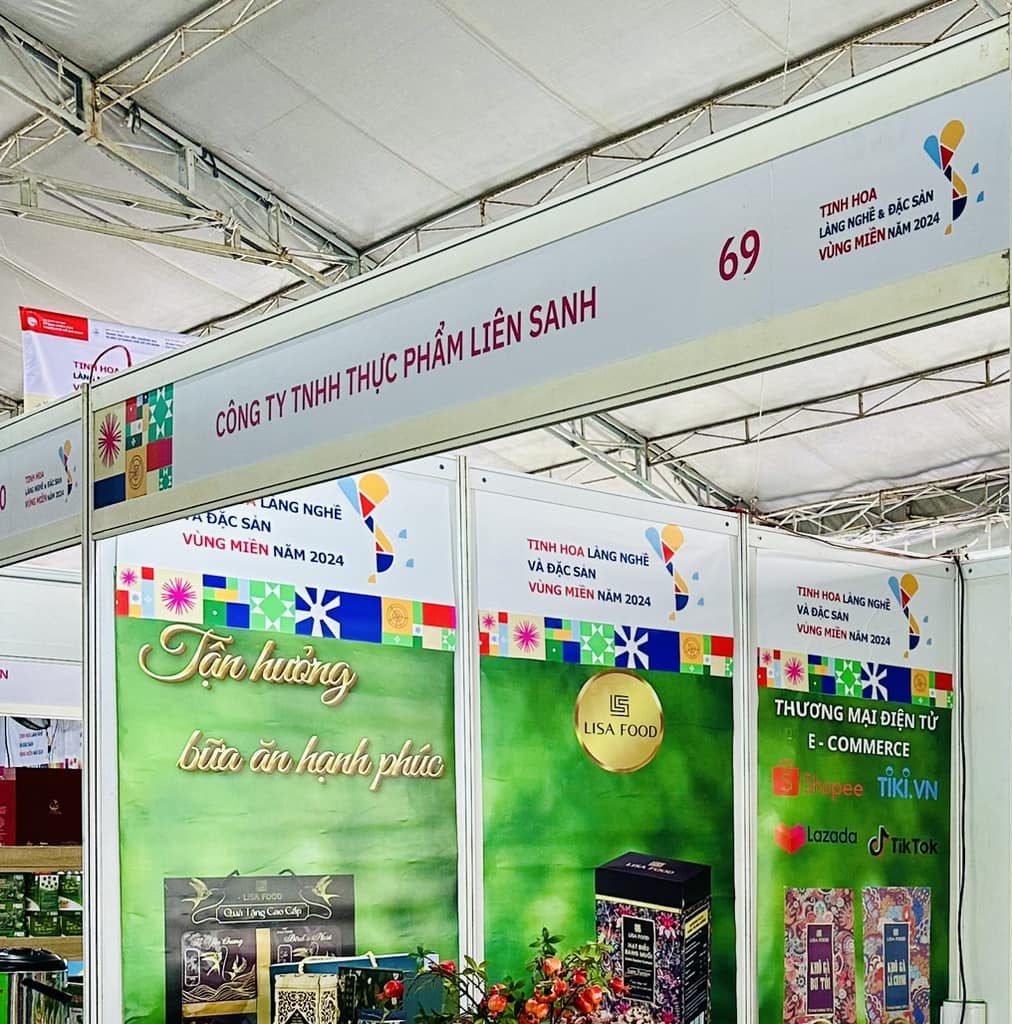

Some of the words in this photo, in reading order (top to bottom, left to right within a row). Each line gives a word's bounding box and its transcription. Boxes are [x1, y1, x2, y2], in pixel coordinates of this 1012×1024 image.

[819, 218, 846, 239] LÀNG
[848, 206, 877, 230] NGHỀ
[878, 209, 886, 219] &
[888, 197, 911, 216] ĐẶC
[911, 189, 935, 209] SẢN
[820, 198, 849, 218] TINH
[851, 187, 878, 209] HOA
[819, 238, 852, 262] VÙNG
[854, 225, 886, 250] MIỀN
[887, 218, 911, 240] NĂM
[913, 211, 941, 232] 2024
[718, 229, 760, 281] 69
[215, 399, 260, 437] CÔNG
[265, 390, 288, 419] TY
[290, 372, 341, 411] TNHH
[345, 353, 398, 395] THỰC
[403, 320, 464, 378] PHẨM
[470, 307, 523, 357] LIÊN
[529, 286, 598, 337] SANH
[206, 510, 238, 529] ĐẶC
[241, 515, 272, 533] SẢN
[303, 504, 343, 520] NGHỀ
[182, 530, 226, 550] VÙNG
[230, 538, 269, 556] MIỀN
[273, 544, 306, 561] NĂM
[310, 551, 344, 567] 2024
[527, 538, 556, 552] TINH
[560, 544, 584, 557] HOA
[587, 545, 617, 561] LÀNG
[620, 552, 650, 566] NGHỀ
[527, 558, 544, 572] VÀ
[547, 561, 571, 577] ĐẶC
[573, 564, 596, 579] SẢN
[528, 579, 562, 596] VÙNG
[565, 584, 595, 600] MIỀN
[597, 588, 622, 603] NĂM
[625, 594, 651, 607] 2024
[797, 586, 820, 599] TINH
[822, 590, 841, 602] HOA
[842, 592, 865, 607] LÀNG
[867, 598, 891, 611] NGHỀ
[797, 602, 809, 616] VÀ
[797, 621, 822, 636] VÙNG
[849, 630, 868, 643] NĂM
[870, 634, 891, 646] 2024
[139, 623, 247, 691] Tận
[250, 640, 358, 707] hưởng
[775, 698, 843, 722] THƯƠNG
[848, 707, 878, 728] MẠI
[880, 708, 915, 732] ĐIỆN
[918, 710, 939, 731] TỬ
[584, 721, 615, 735] LISA
[620, 723, 658, 738] FOOD
[808, 733, 816, 749] E
[827, 735, 910, 757] COMMERCE
[177, 729, 243, 773] bữa
[250, 738, 291, 774] ăn
[296, 735, 373, 783] hạnh
[370, 739, 445, 791] phúc
[803, 772, 864, 801] Shopee
[807, 825, 858, 844] Lazada
[891, 837, 939, 855] TikTok
